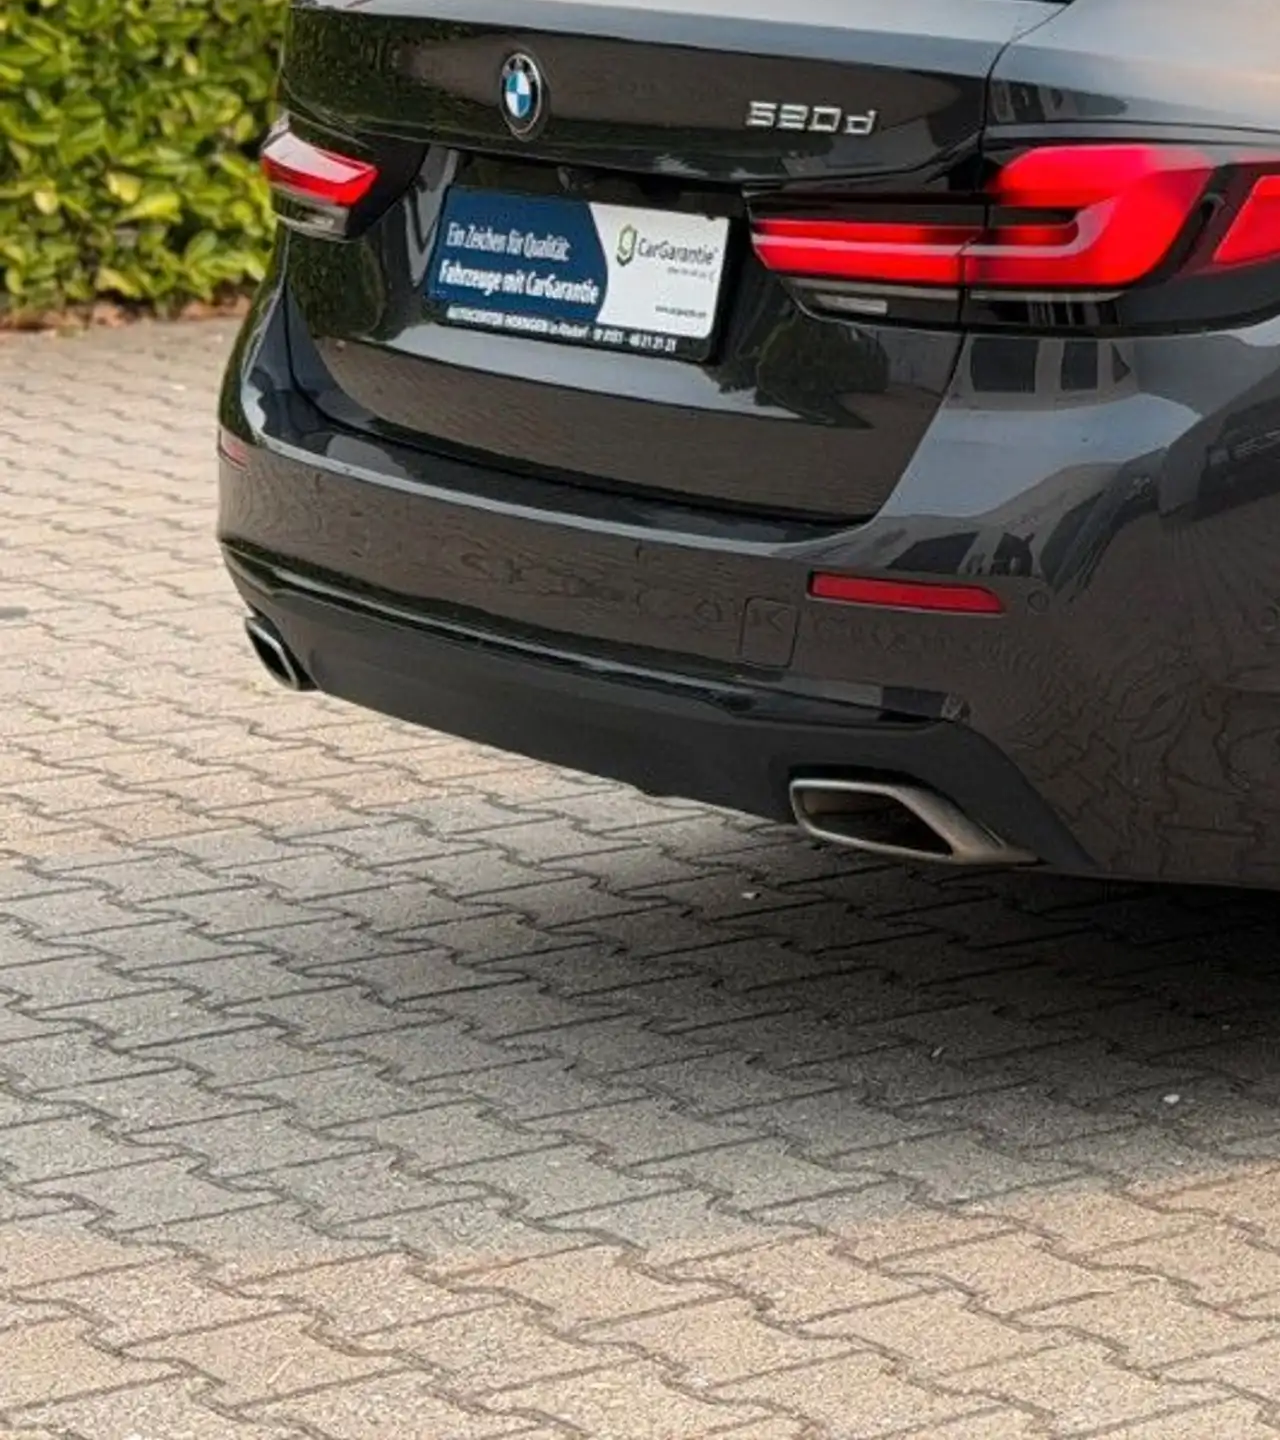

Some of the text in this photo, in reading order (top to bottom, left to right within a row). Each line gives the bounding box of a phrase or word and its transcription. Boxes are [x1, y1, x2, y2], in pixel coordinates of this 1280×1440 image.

[445, 221, 464, 247] Ein
[464, 223, 506, 253] Zeichen
[506, 228, 524, 256] für
[438, 258, 600, 305] Fahrzeuge mit CarGarantie
